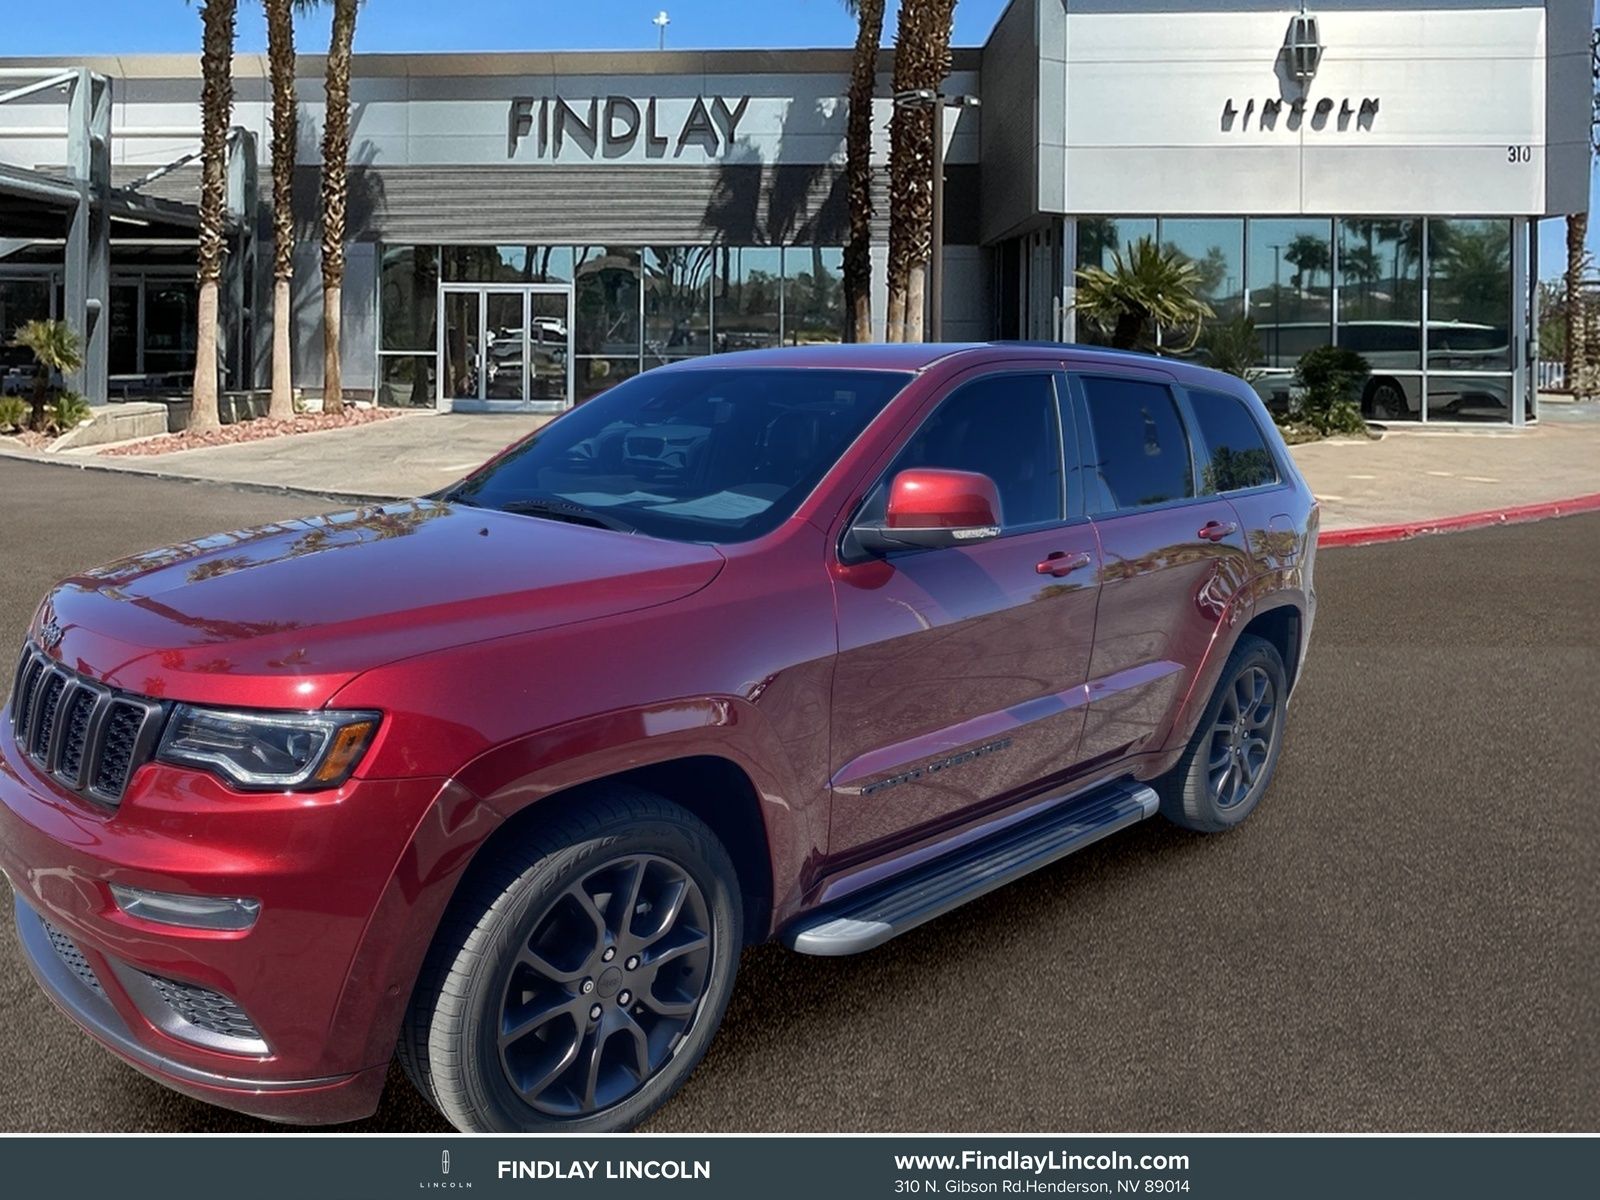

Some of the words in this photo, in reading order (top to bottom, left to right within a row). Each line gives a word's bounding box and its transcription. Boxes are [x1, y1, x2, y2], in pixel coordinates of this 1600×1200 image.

[508, 95, 751, 154] FINDLAY
[1222, 97, 1380, 129] LINCOLN
[1507, 145, 1531, 163] 310
